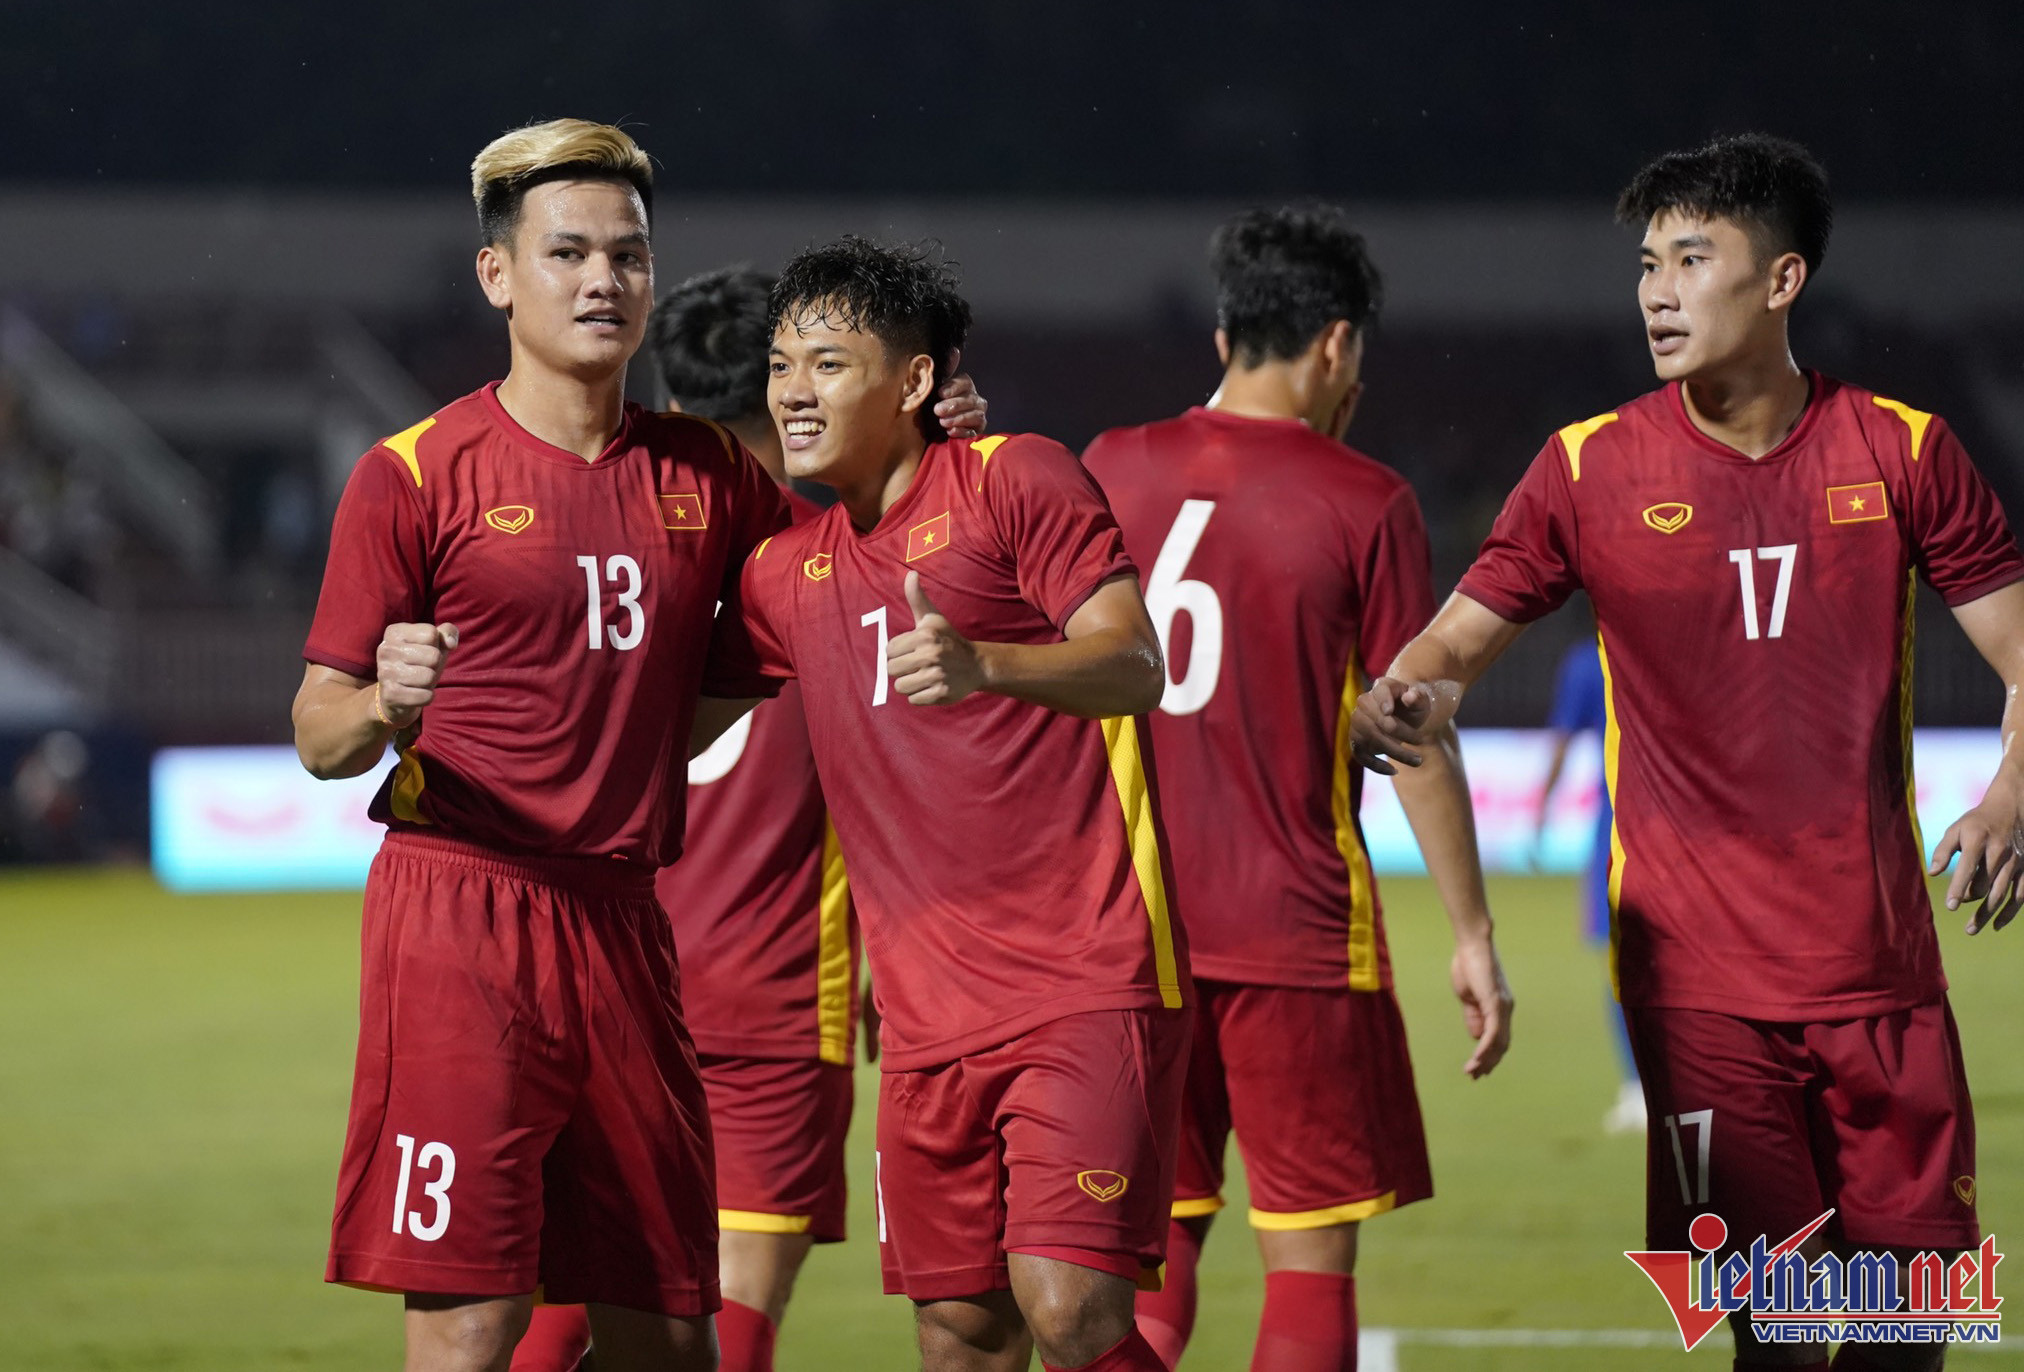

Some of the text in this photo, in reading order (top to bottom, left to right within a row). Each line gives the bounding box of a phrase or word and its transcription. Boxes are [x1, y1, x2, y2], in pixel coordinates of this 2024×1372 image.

[576, 554, 646, 651] 13
[1145, 499, 1223, 716] 6
[1728, 543, 1798, 641] 17
[392, 1133, 457, 1242] 13
[1664, 1108, 1714, 1206] 17
